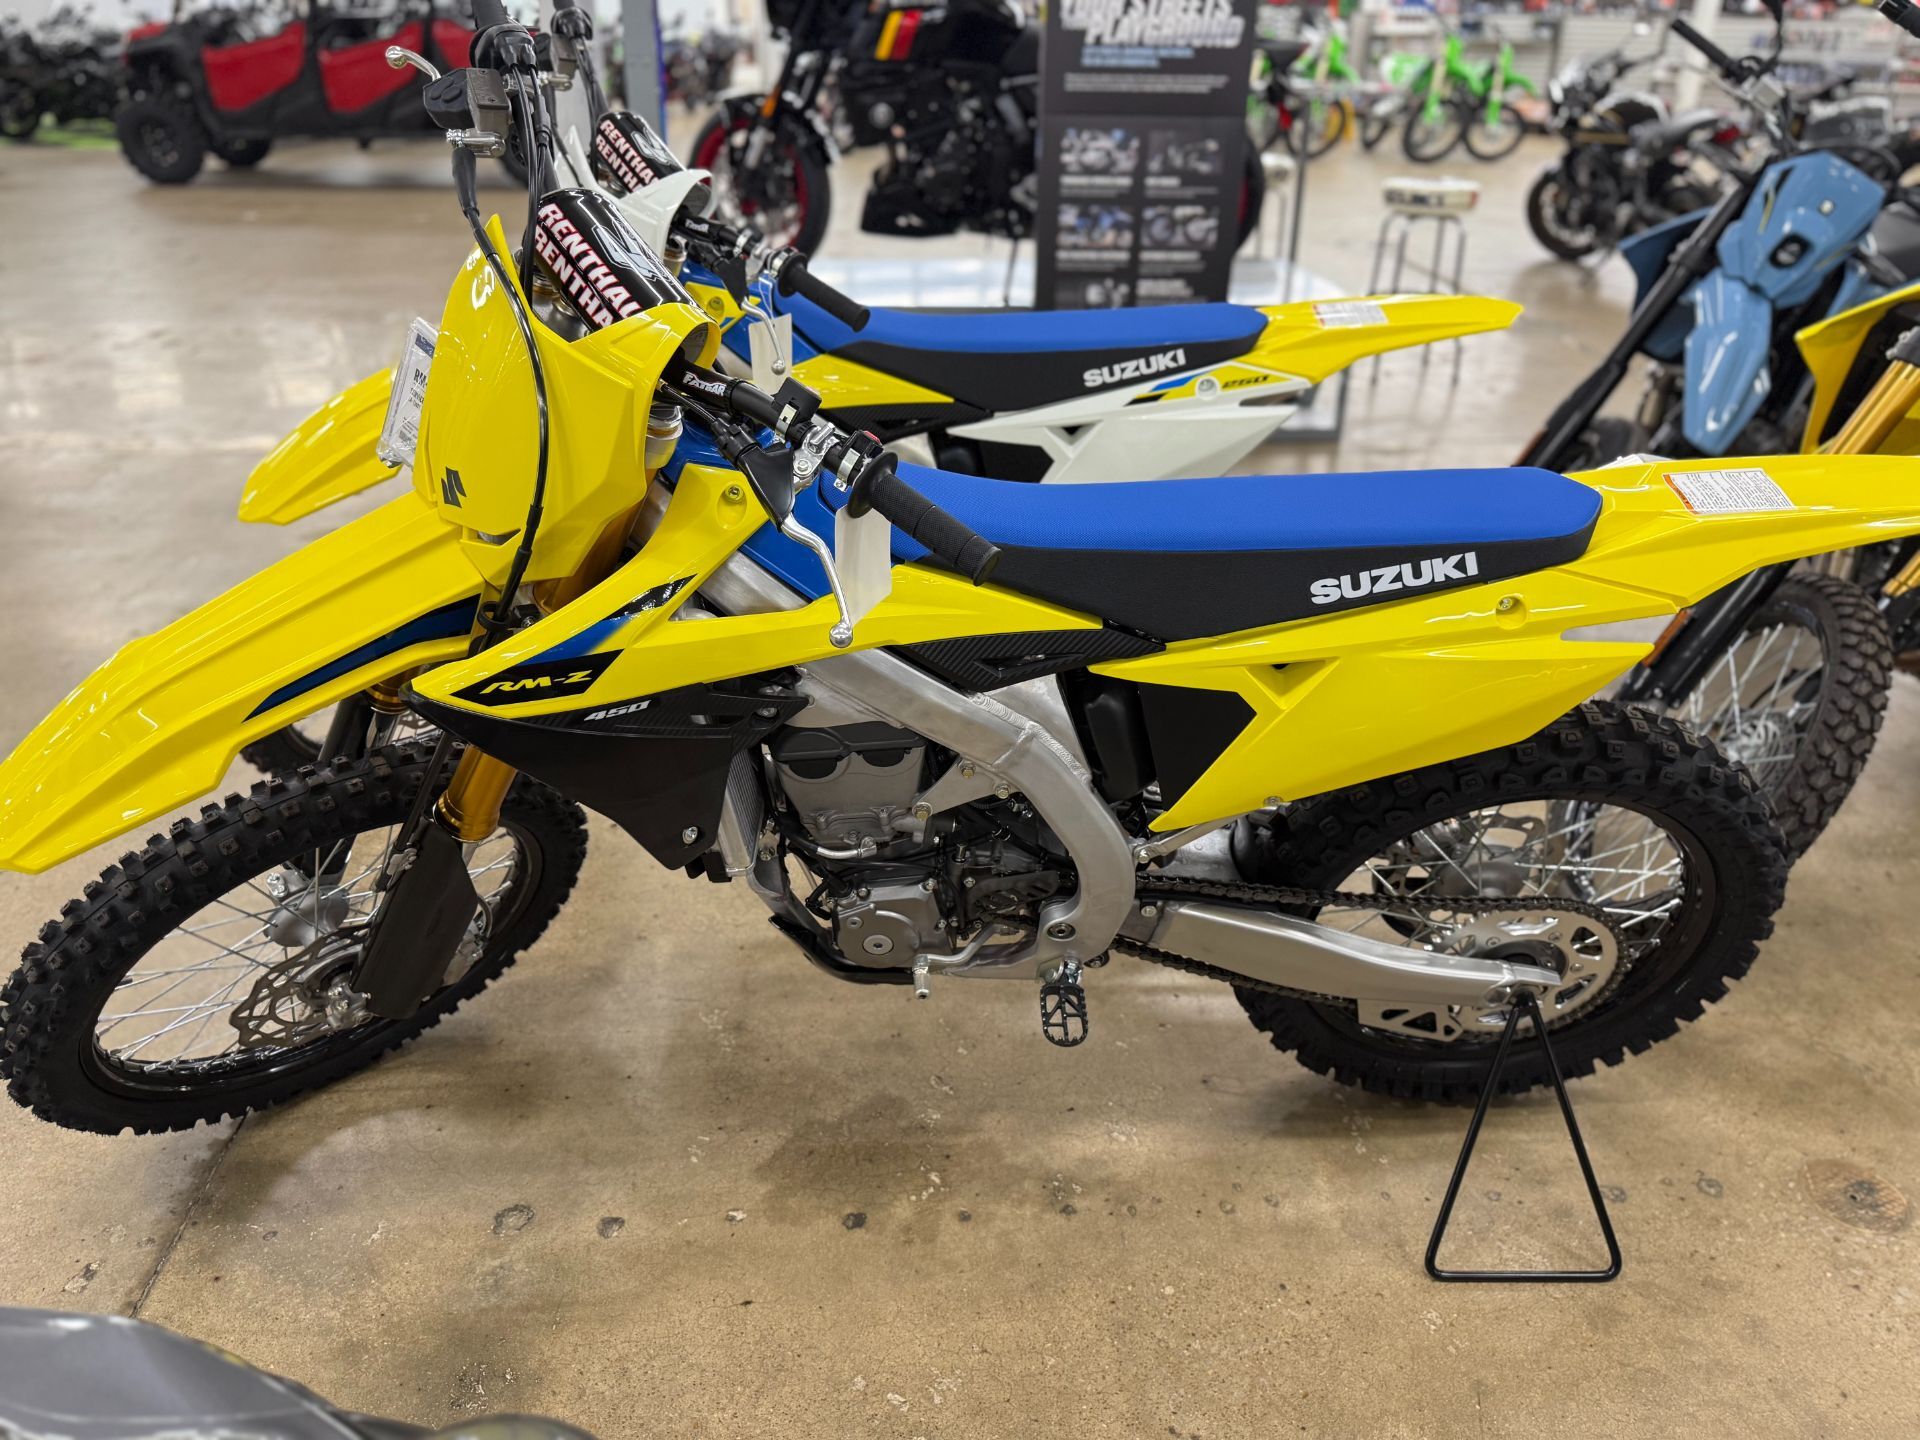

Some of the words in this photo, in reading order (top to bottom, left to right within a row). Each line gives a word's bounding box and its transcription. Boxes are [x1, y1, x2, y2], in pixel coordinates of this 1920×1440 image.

[1084, 16, 1246, 48] PLAYGROUND
[596, 134, 641, 192] RENTH
[534, 224, 615, 331] RENTHA
[1083, 348, 1187, 388] SUZUKI
[1222, 374, 1270, 389] 250
[1309, 551, 1480, 606] SUZUKI
[479, 669, 593, 695] RM-Z
[583, 699, 653, 722] 450
